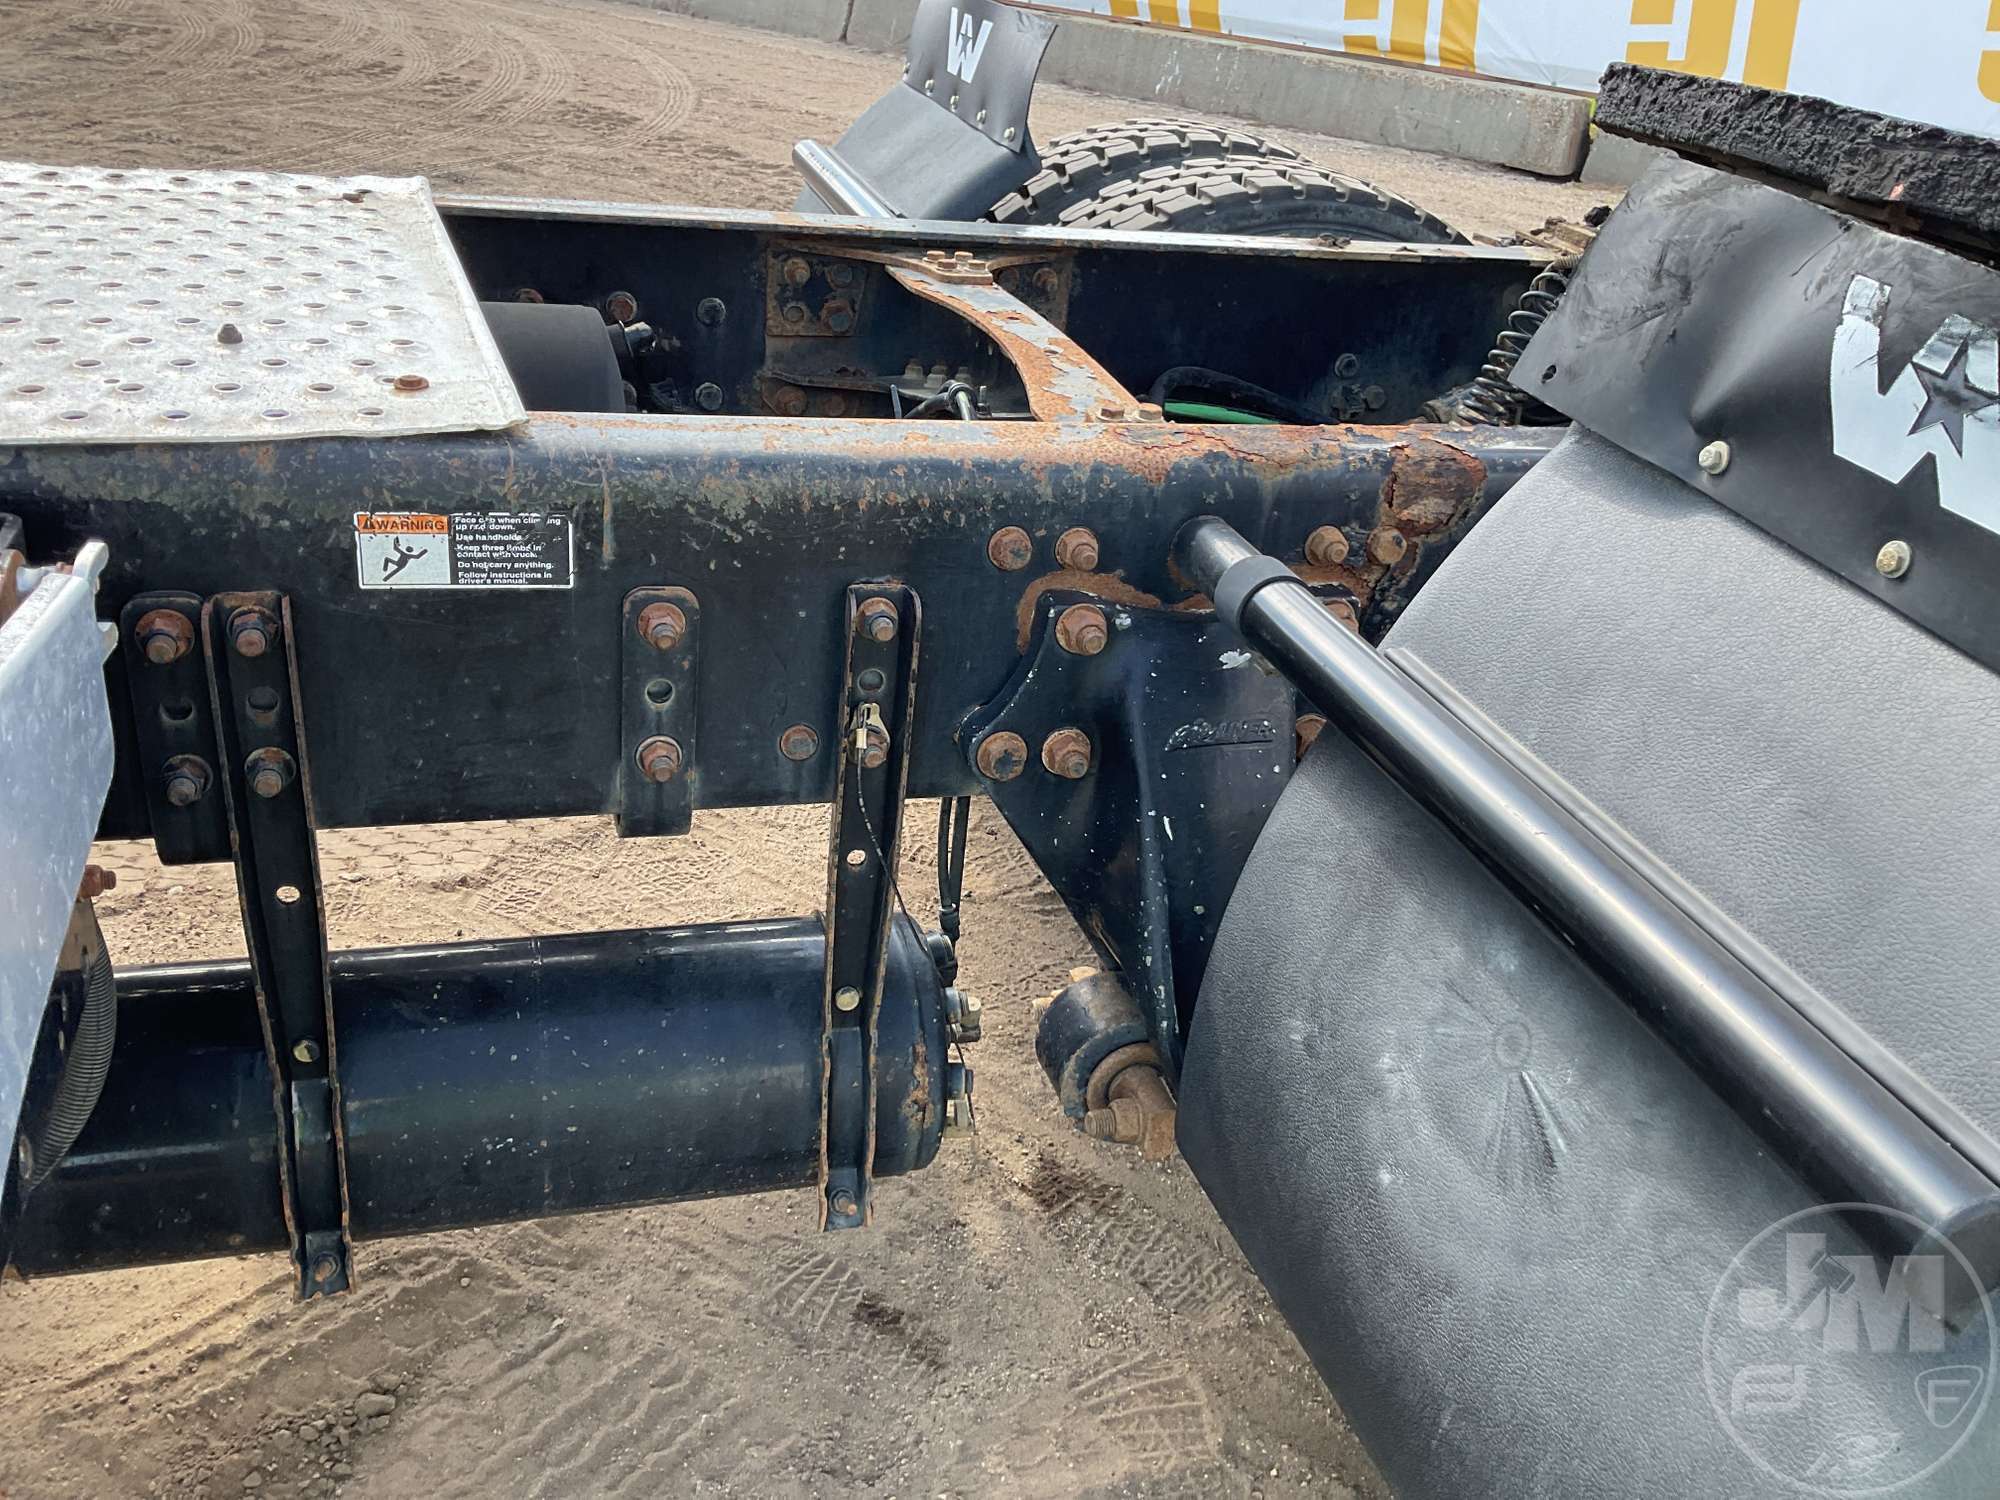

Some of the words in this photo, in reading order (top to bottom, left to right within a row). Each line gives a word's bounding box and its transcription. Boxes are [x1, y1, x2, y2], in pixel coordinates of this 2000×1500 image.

[376, 515, 446, 531] WARNING
[454, 516, 477, 524] Face
[497, 516, 521, 524] when
[455, 533, 474, 541] Use
[456, 544, 480, 552] Keep
[482, 543, 505, 551] three
[489, 561, 512, 569] carry
[513, 560, 555, 570] anything.
[458, 571, 488, 579] Follow
[489, 571, 542, 579] instructions
[543, 571, 552, 579] in
